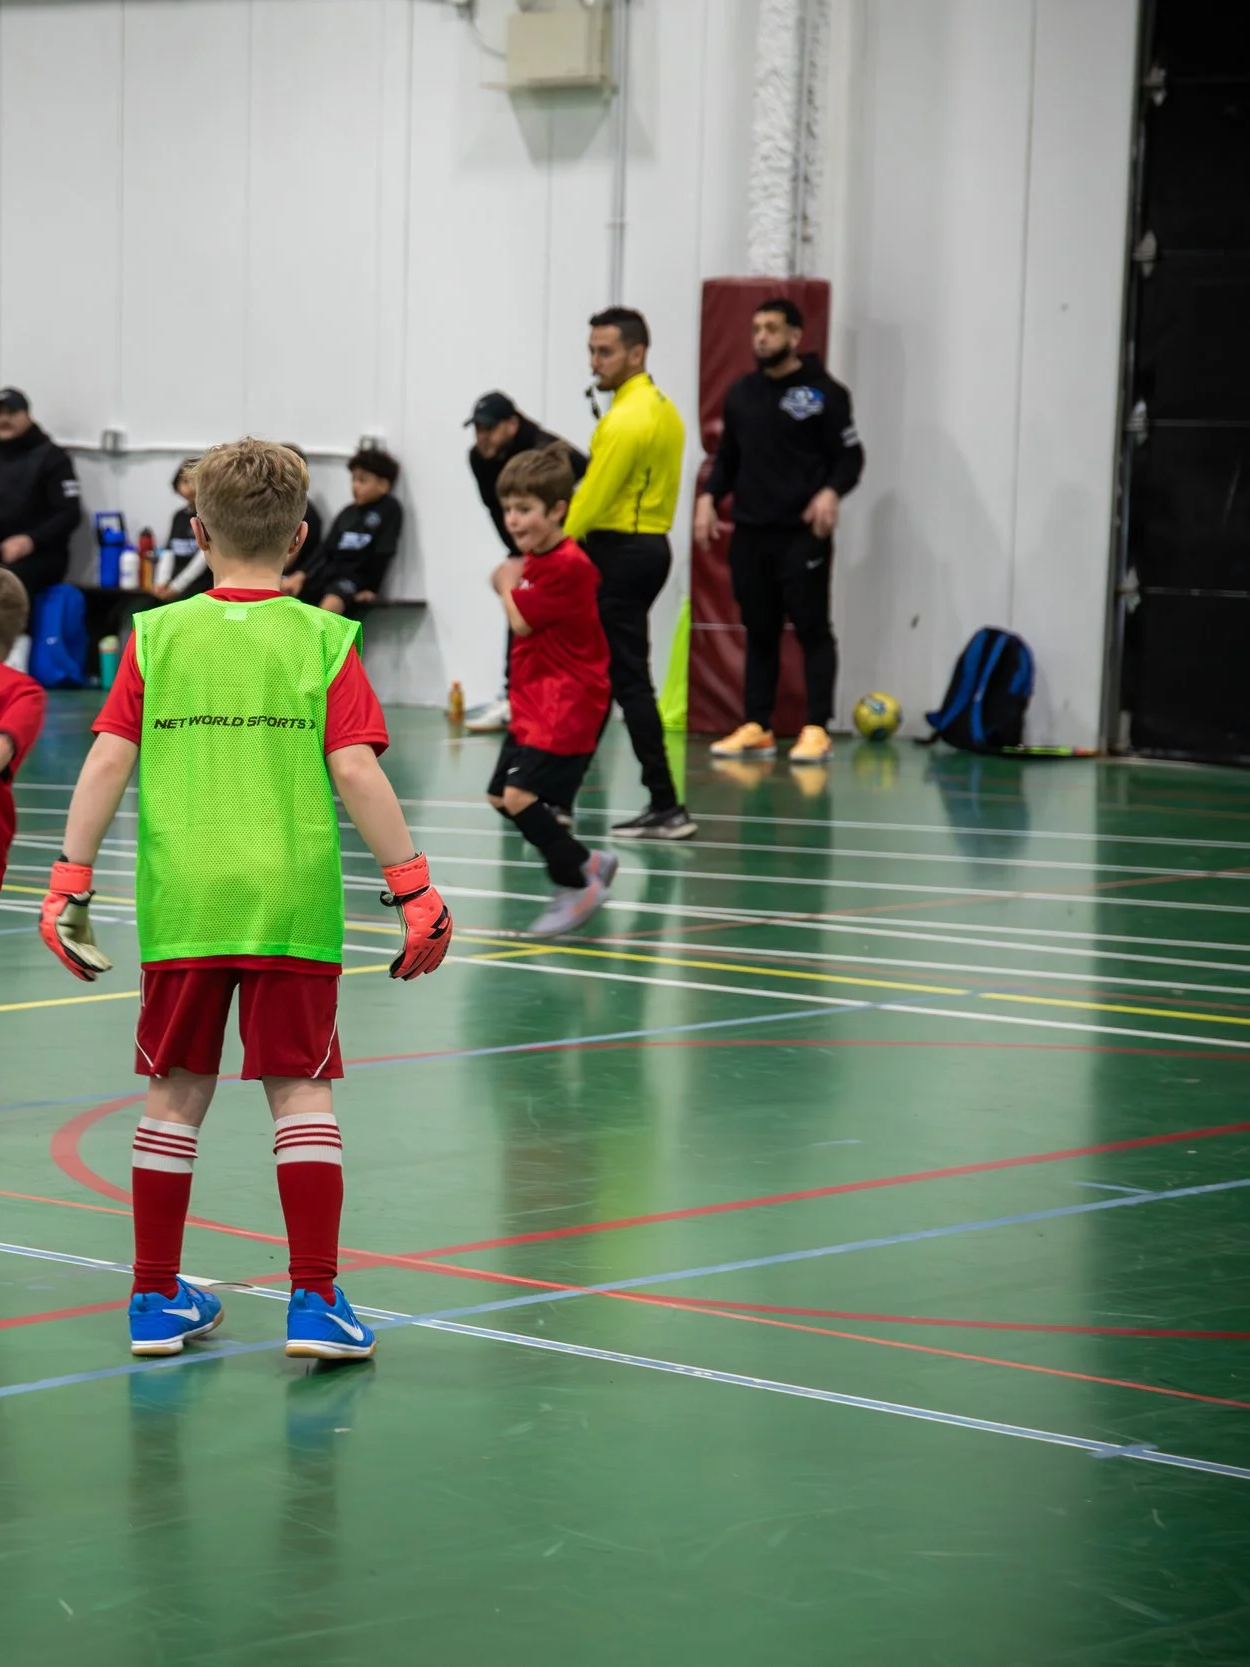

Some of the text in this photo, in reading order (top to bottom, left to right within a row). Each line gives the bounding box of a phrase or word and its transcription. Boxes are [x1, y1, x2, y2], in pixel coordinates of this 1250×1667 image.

[153, 715, 307, 730] NET WORLD SPORTS
